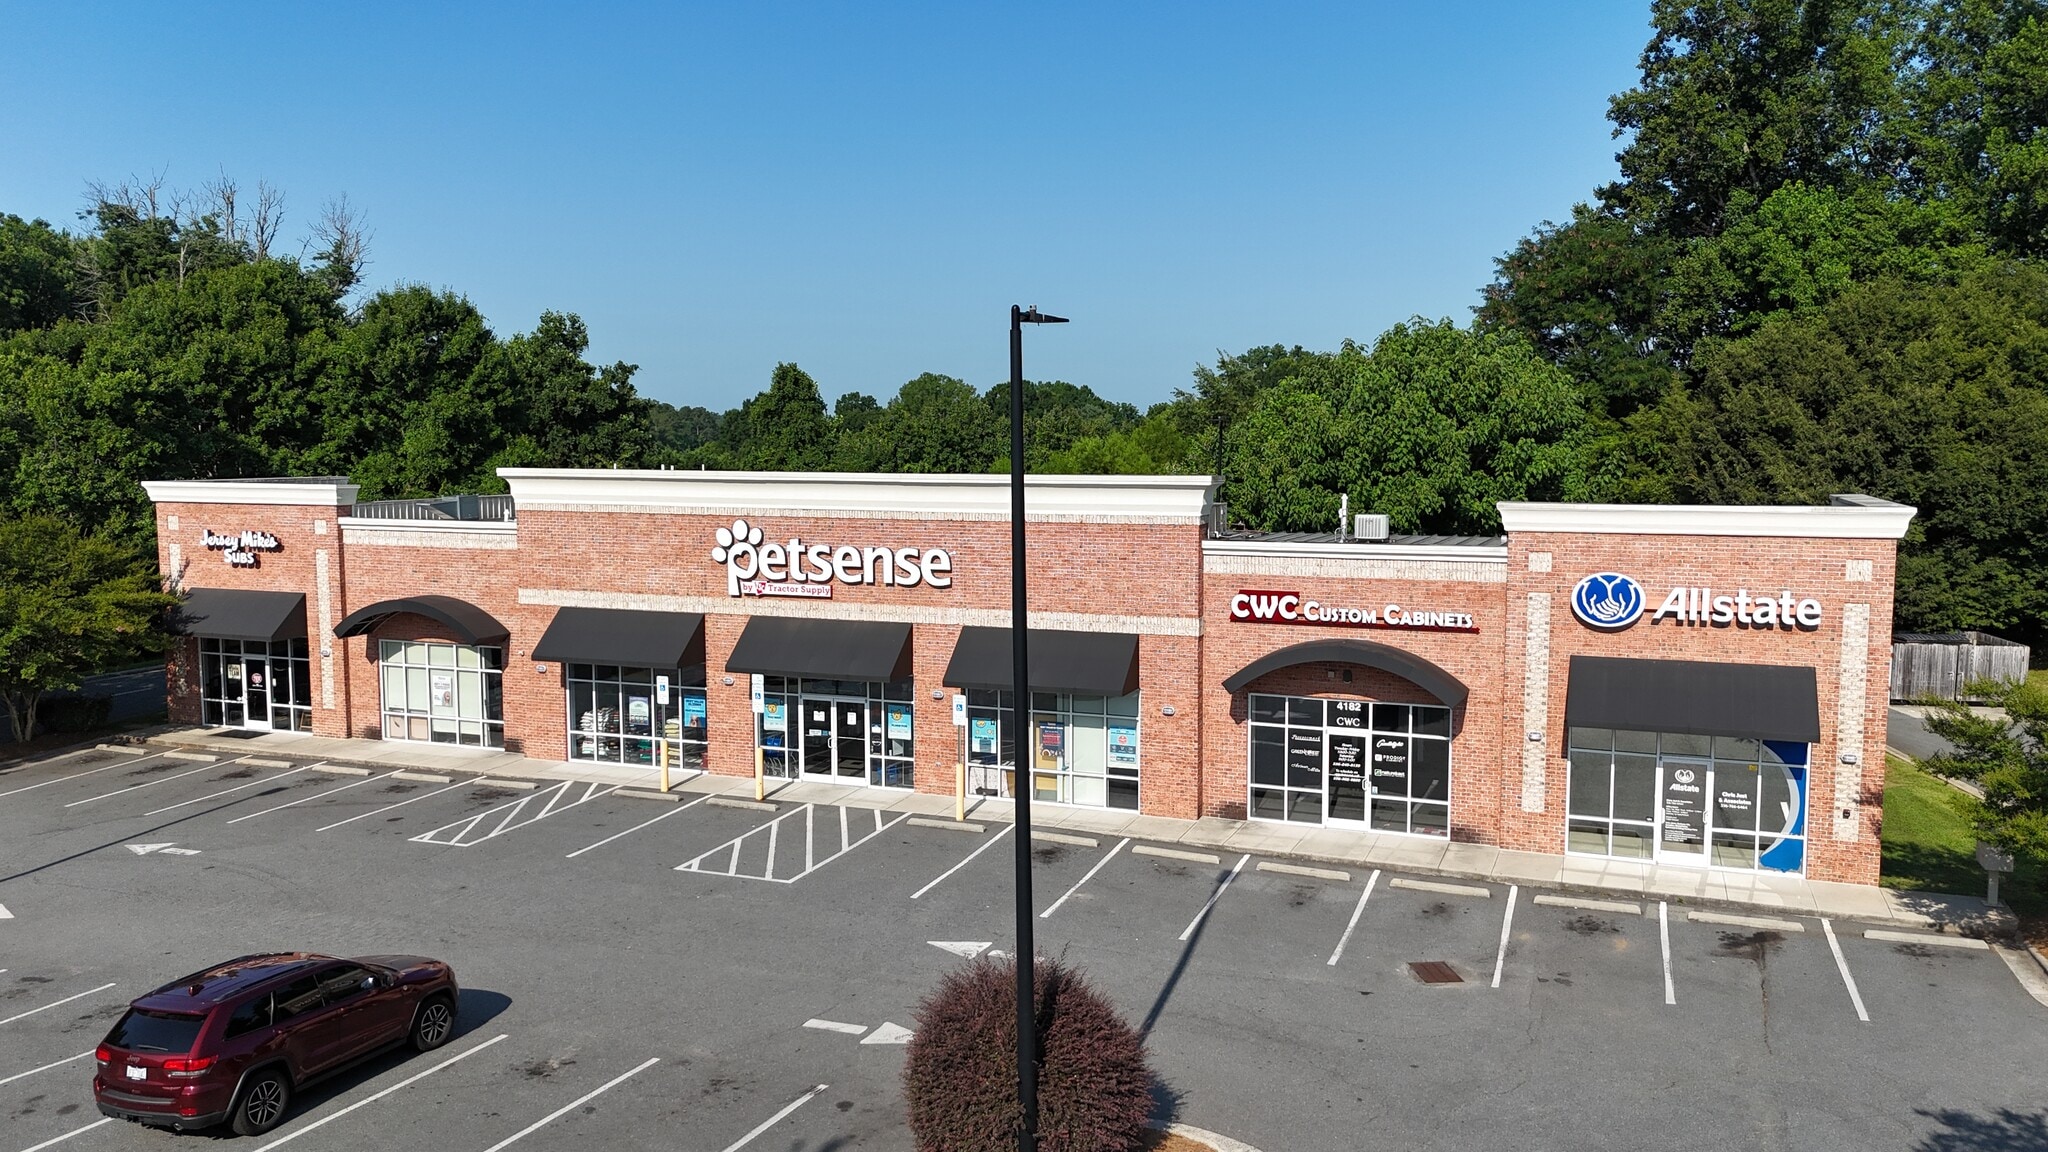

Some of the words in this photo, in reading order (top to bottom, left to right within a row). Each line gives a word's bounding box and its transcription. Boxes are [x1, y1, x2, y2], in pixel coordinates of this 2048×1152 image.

[200, 529, 239, 550] Jersey
[241, 530, 278, 548] Mike's
[727, 538, 952, 597] petsense
[742, 583, 753, 591] by
[768, 584, 799, 593] Tractor
[800, 585, 830, 595] Supply
[1230, 593, 1299, 620] CWC
[1652, 587, 1822, 626] Allstate
[1336, 701, 1362, 712] 4182
[1336, 716, 1361, 727] CWC
[1669, 782, 1700, 793] Allstate
